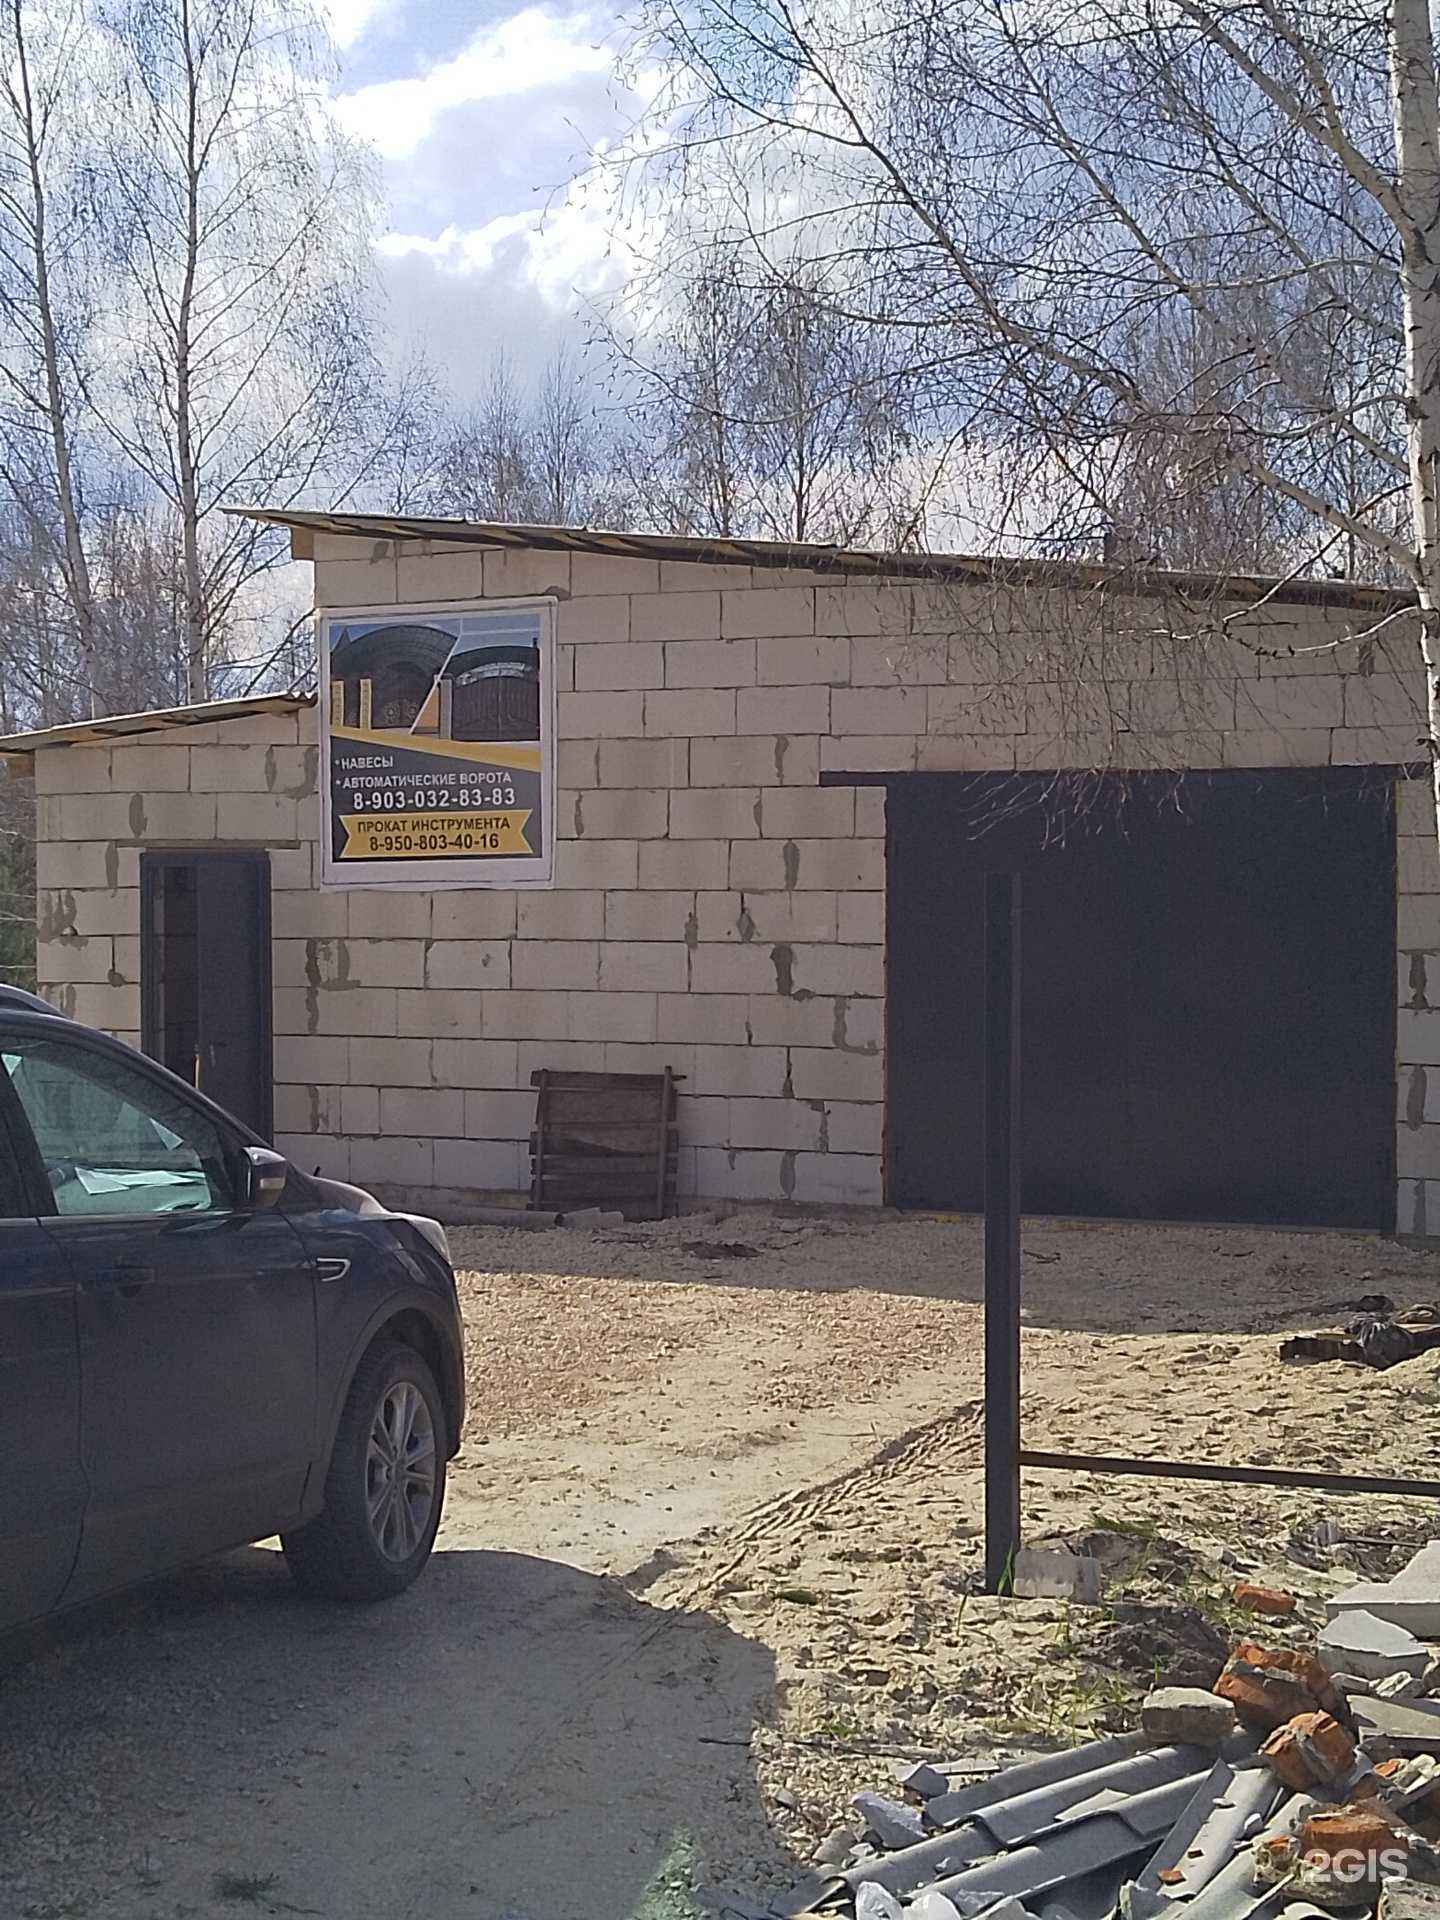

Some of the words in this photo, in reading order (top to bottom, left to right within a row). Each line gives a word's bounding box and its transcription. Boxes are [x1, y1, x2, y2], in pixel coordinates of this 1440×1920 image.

[341, 756, 393, 769] НАВЕСЫ
[342, 774, 456, 789] АВТОМАТИЧЕСКИЕ
[460, 772, 512, 784] ВОРОТА
[353, 788, 516, 810] 8-903-032-83-83
[358, 819, 408, 833] ПРОКАТ
[412, 817, 510, 831] ИНСТРУМЕНТА
[370, 833, 499, 851] 8-950-803-40-16
